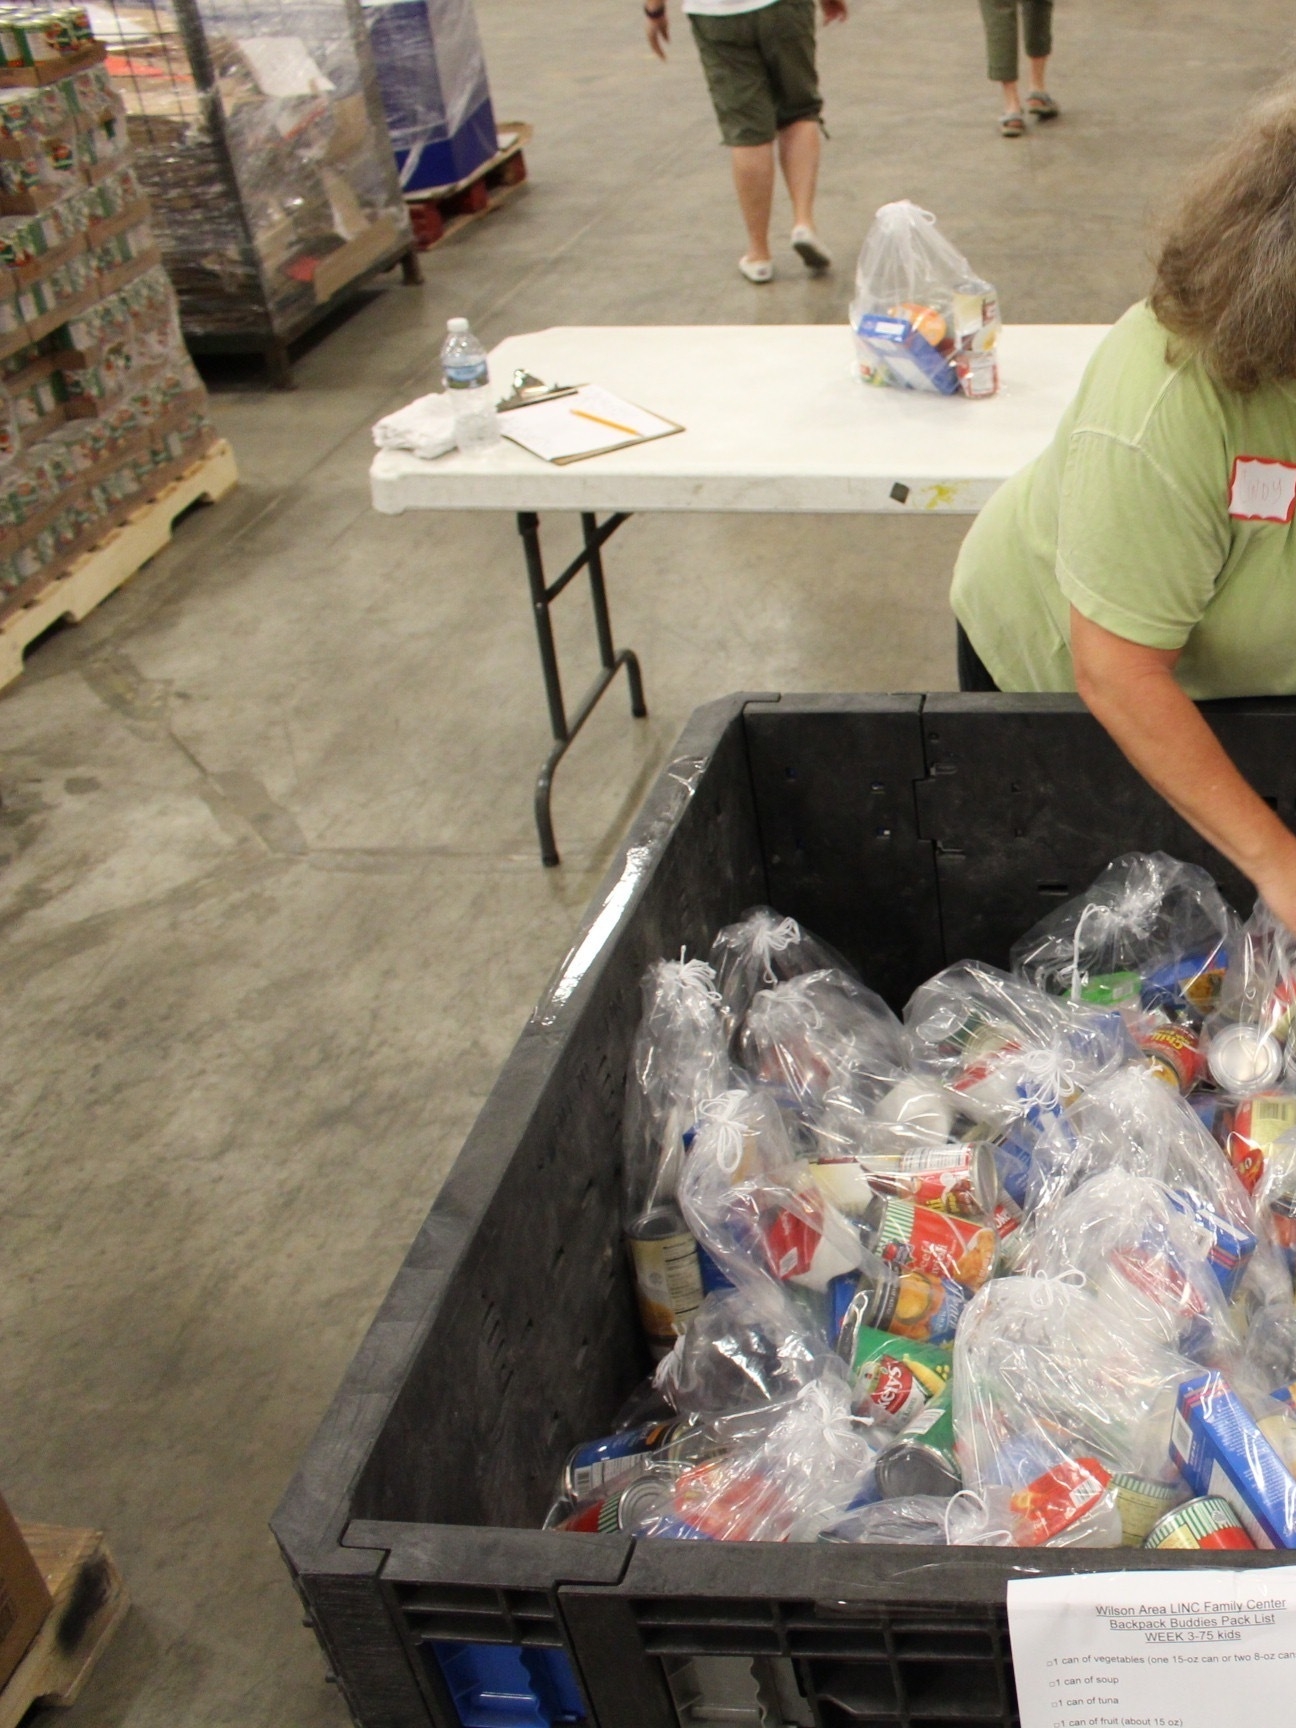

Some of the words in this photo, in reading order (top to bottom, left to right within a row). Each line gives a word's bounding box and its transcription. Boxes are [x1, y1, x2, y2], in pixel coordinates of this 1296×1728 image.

[1096, 1606, 1134, 1616] Wilson
[1139, 1605, 1166, 1614] Area
[1171, 1602, 1199, 1613] LINC
[1204, 1601, 1242, 1613] Family
[1247, 1599, 1286, 1609] Center
[1110, 1619, 1166, 1630] Backpack
[1170, 1616, 1217, 1628] Buddies
[1222, 1615, 1250, 1625] Pack
[1254, 1613, 1275, 1623] List
[1145, 1632, 1184, 1642] WEEK
[1188, 1631, 1214, 1641] 3-75
[1218, 1630, 1241, 1639] kids
[1082, 1655, 1091, 1663] of
[1094, 1655, 1145, 1664] vegetables
[1147, 1656, 1169, 1665] (one
[1172, 1655, 1199, 1664] 15-oz
[1234, 1654, 1251, 1662] two
[1254, 1652, 1275, 1661] 8-oz
[1084, 1676, 1093, 1684] of
[1096, 1677, 1119, 1685] soup
[1086, 1697, 1096, 1705] of
[1069, 1719, 1086, 1727] can
[1088, 1717, 1098, 1726] of
[1100, 1717, 1119, 1725] fruit
[1121, 1717, 1151, 1726] (about
[1155, 1717, 1165, 1726] 15
[1168, 1718, 1183, 1727] oz)
